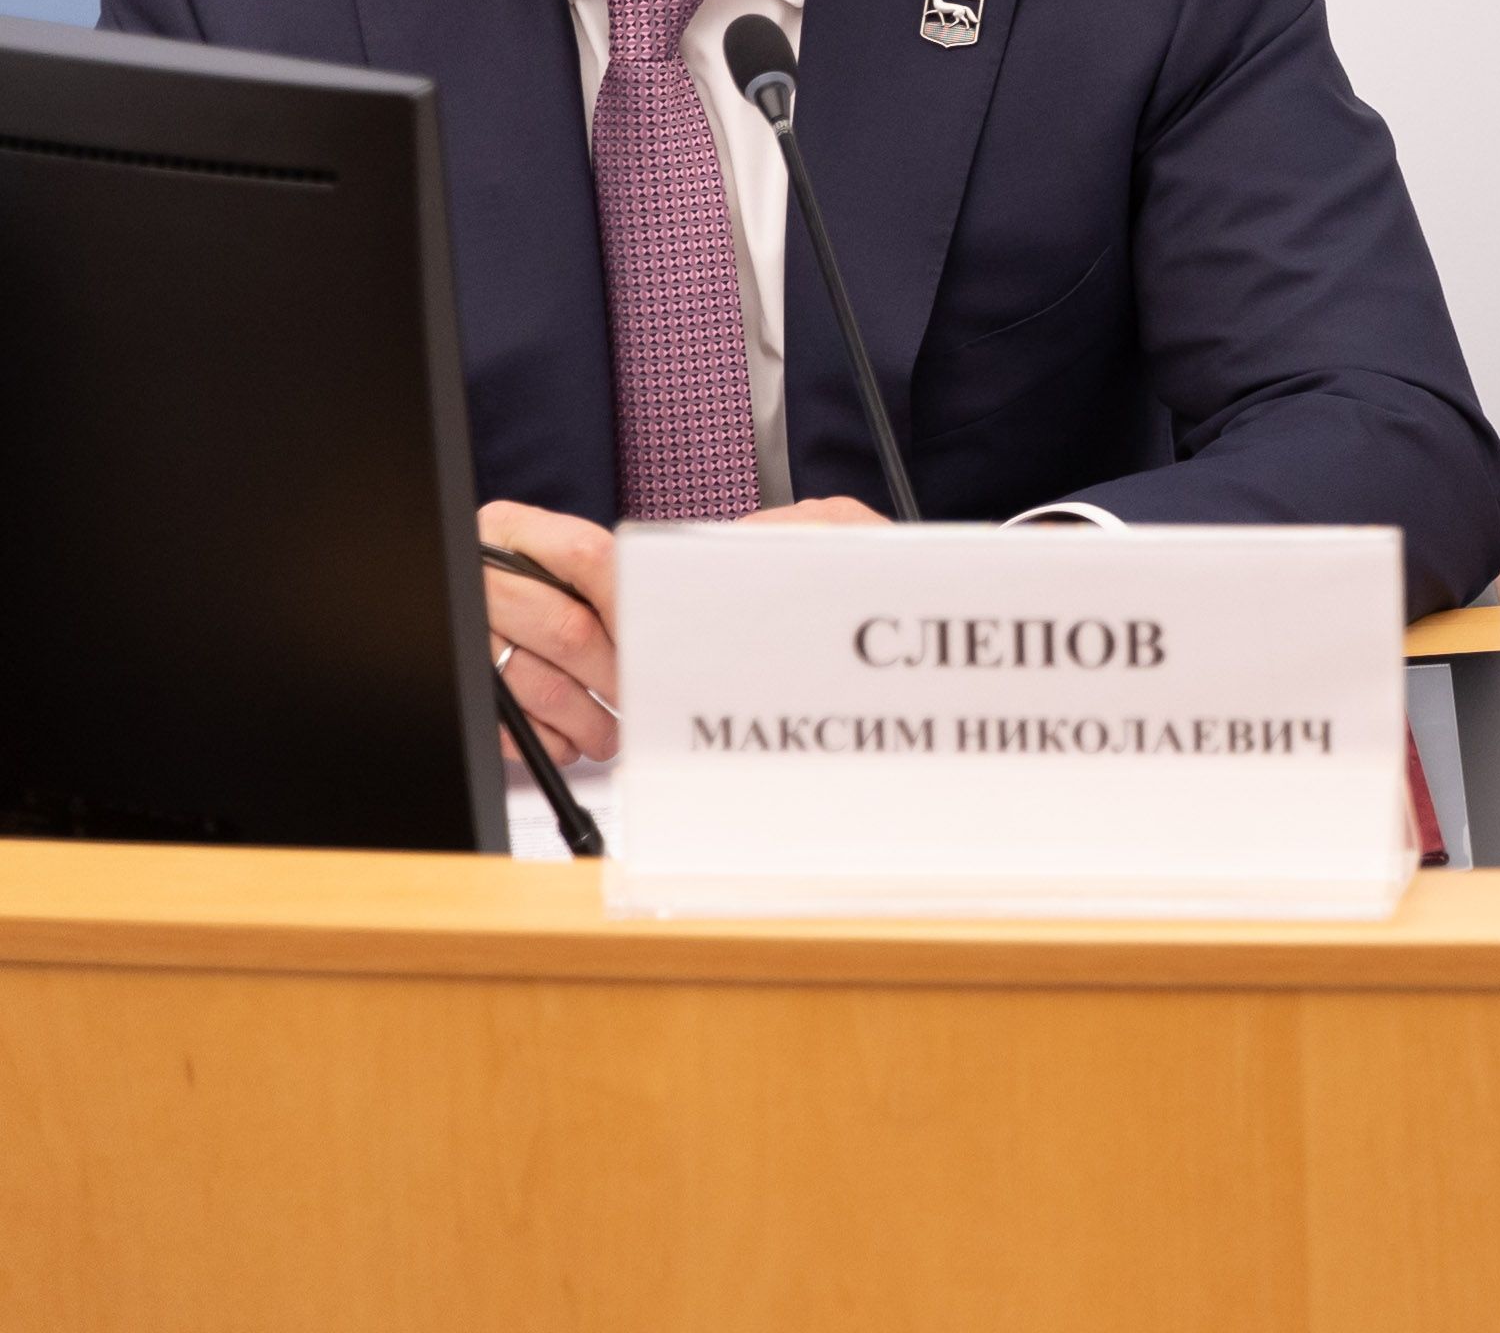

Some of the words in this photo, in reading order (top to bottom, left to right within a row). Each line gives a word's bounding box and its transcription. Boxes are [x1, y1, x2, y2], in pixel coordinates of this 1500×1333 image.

[852, 617, 1168, 669] СЛЕПОВ
[690, 715, 936, 755] МАКСИМ
[955, 717, 1334, 756] НИКОЛАЕВИЧ
